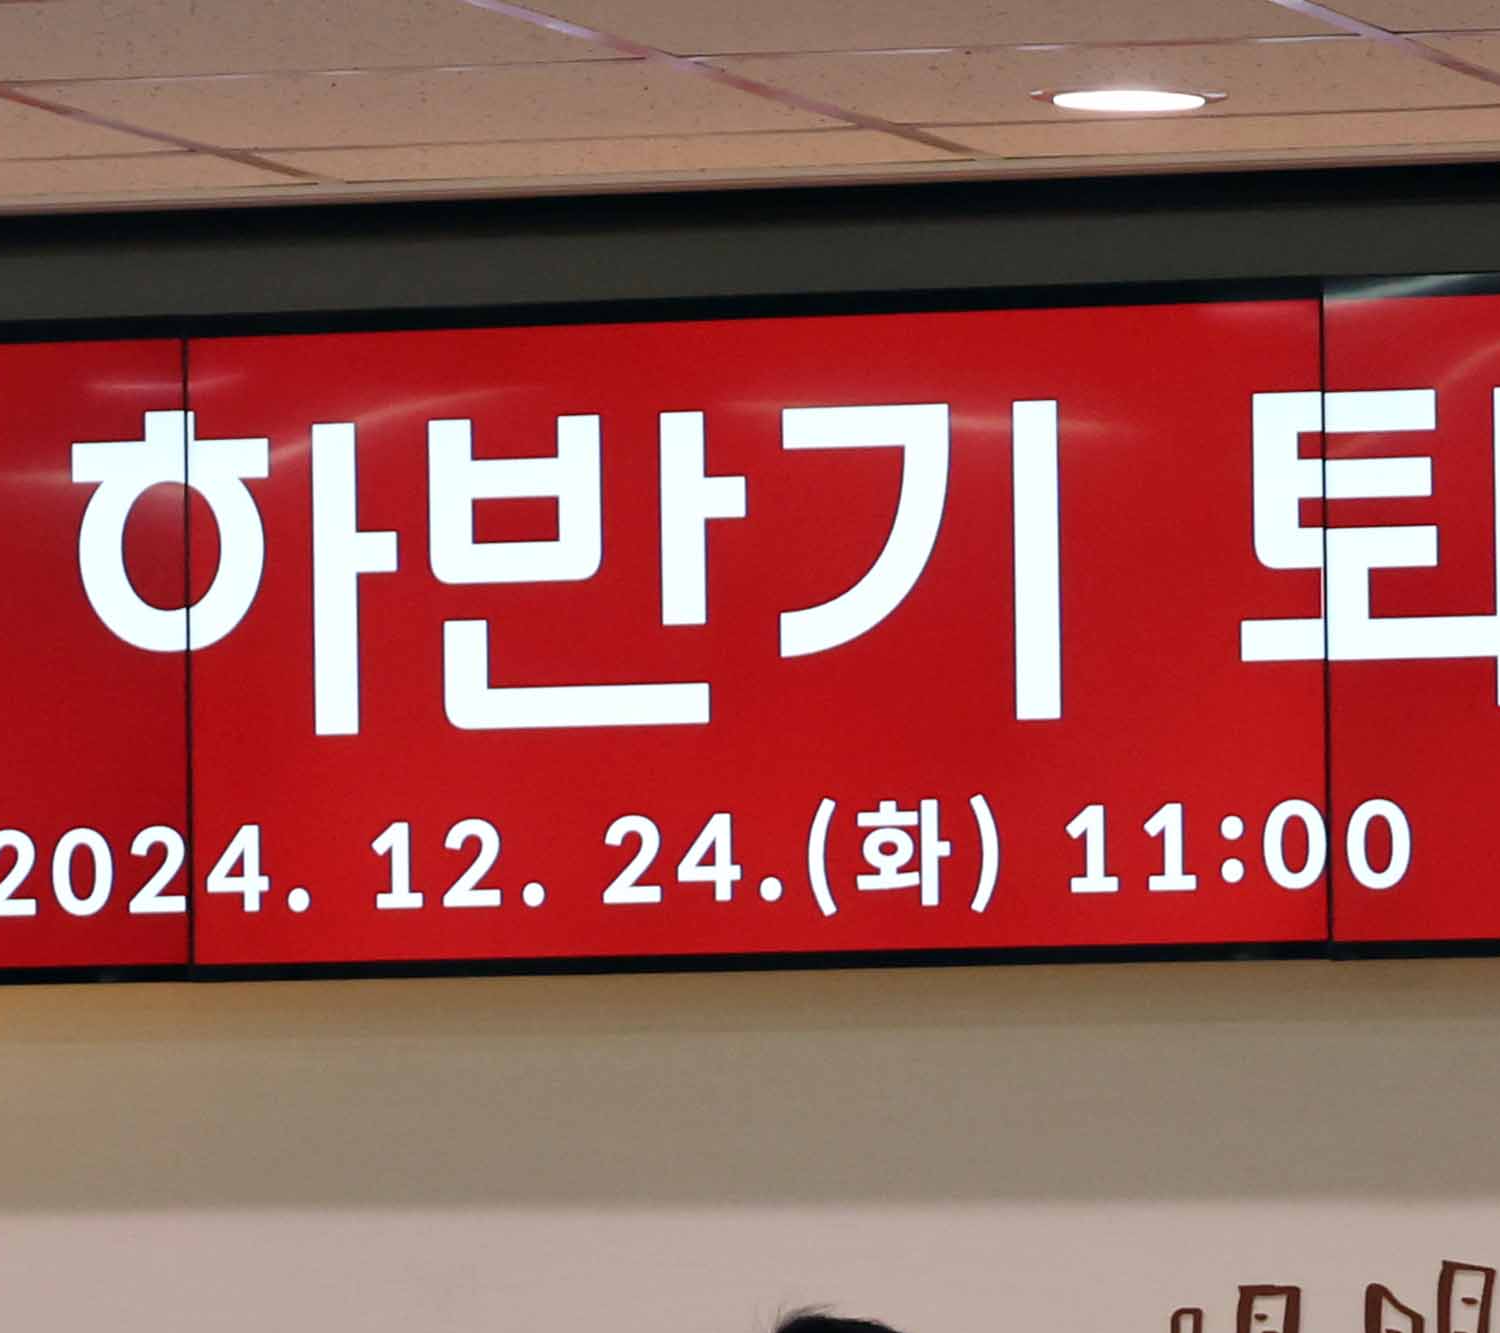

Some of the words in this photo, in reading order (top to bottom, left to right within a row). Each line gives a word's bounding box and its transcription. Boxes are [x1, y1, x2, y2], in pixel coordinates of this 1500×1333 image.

[70, 398, 1062, 737] 하반기
[370, 817, 546, 910] 12.
[603, 793, 1000, 918] 24.(화)
[1064, 798, 1412, 894] 11:00
